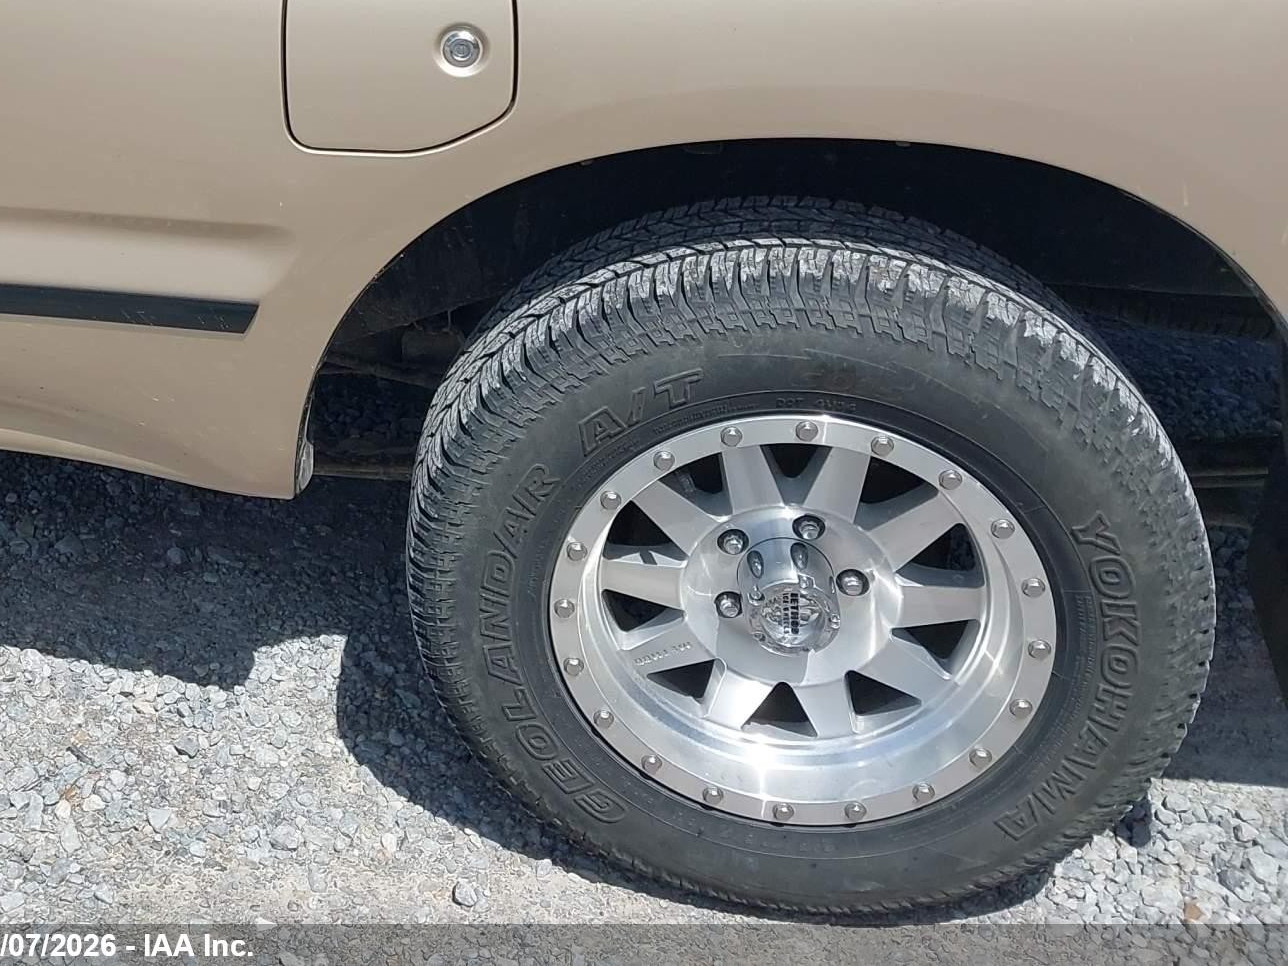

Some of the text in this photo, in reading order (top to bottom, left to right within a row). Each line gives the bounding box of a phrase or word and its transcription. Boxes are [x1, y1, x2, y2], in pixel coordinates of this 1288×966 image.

[579, 369, 704, 456] A/T
[479, 462, 627, 824] GEOLANDAR
[994, 511, 1142, 842] YOKOHAMA
